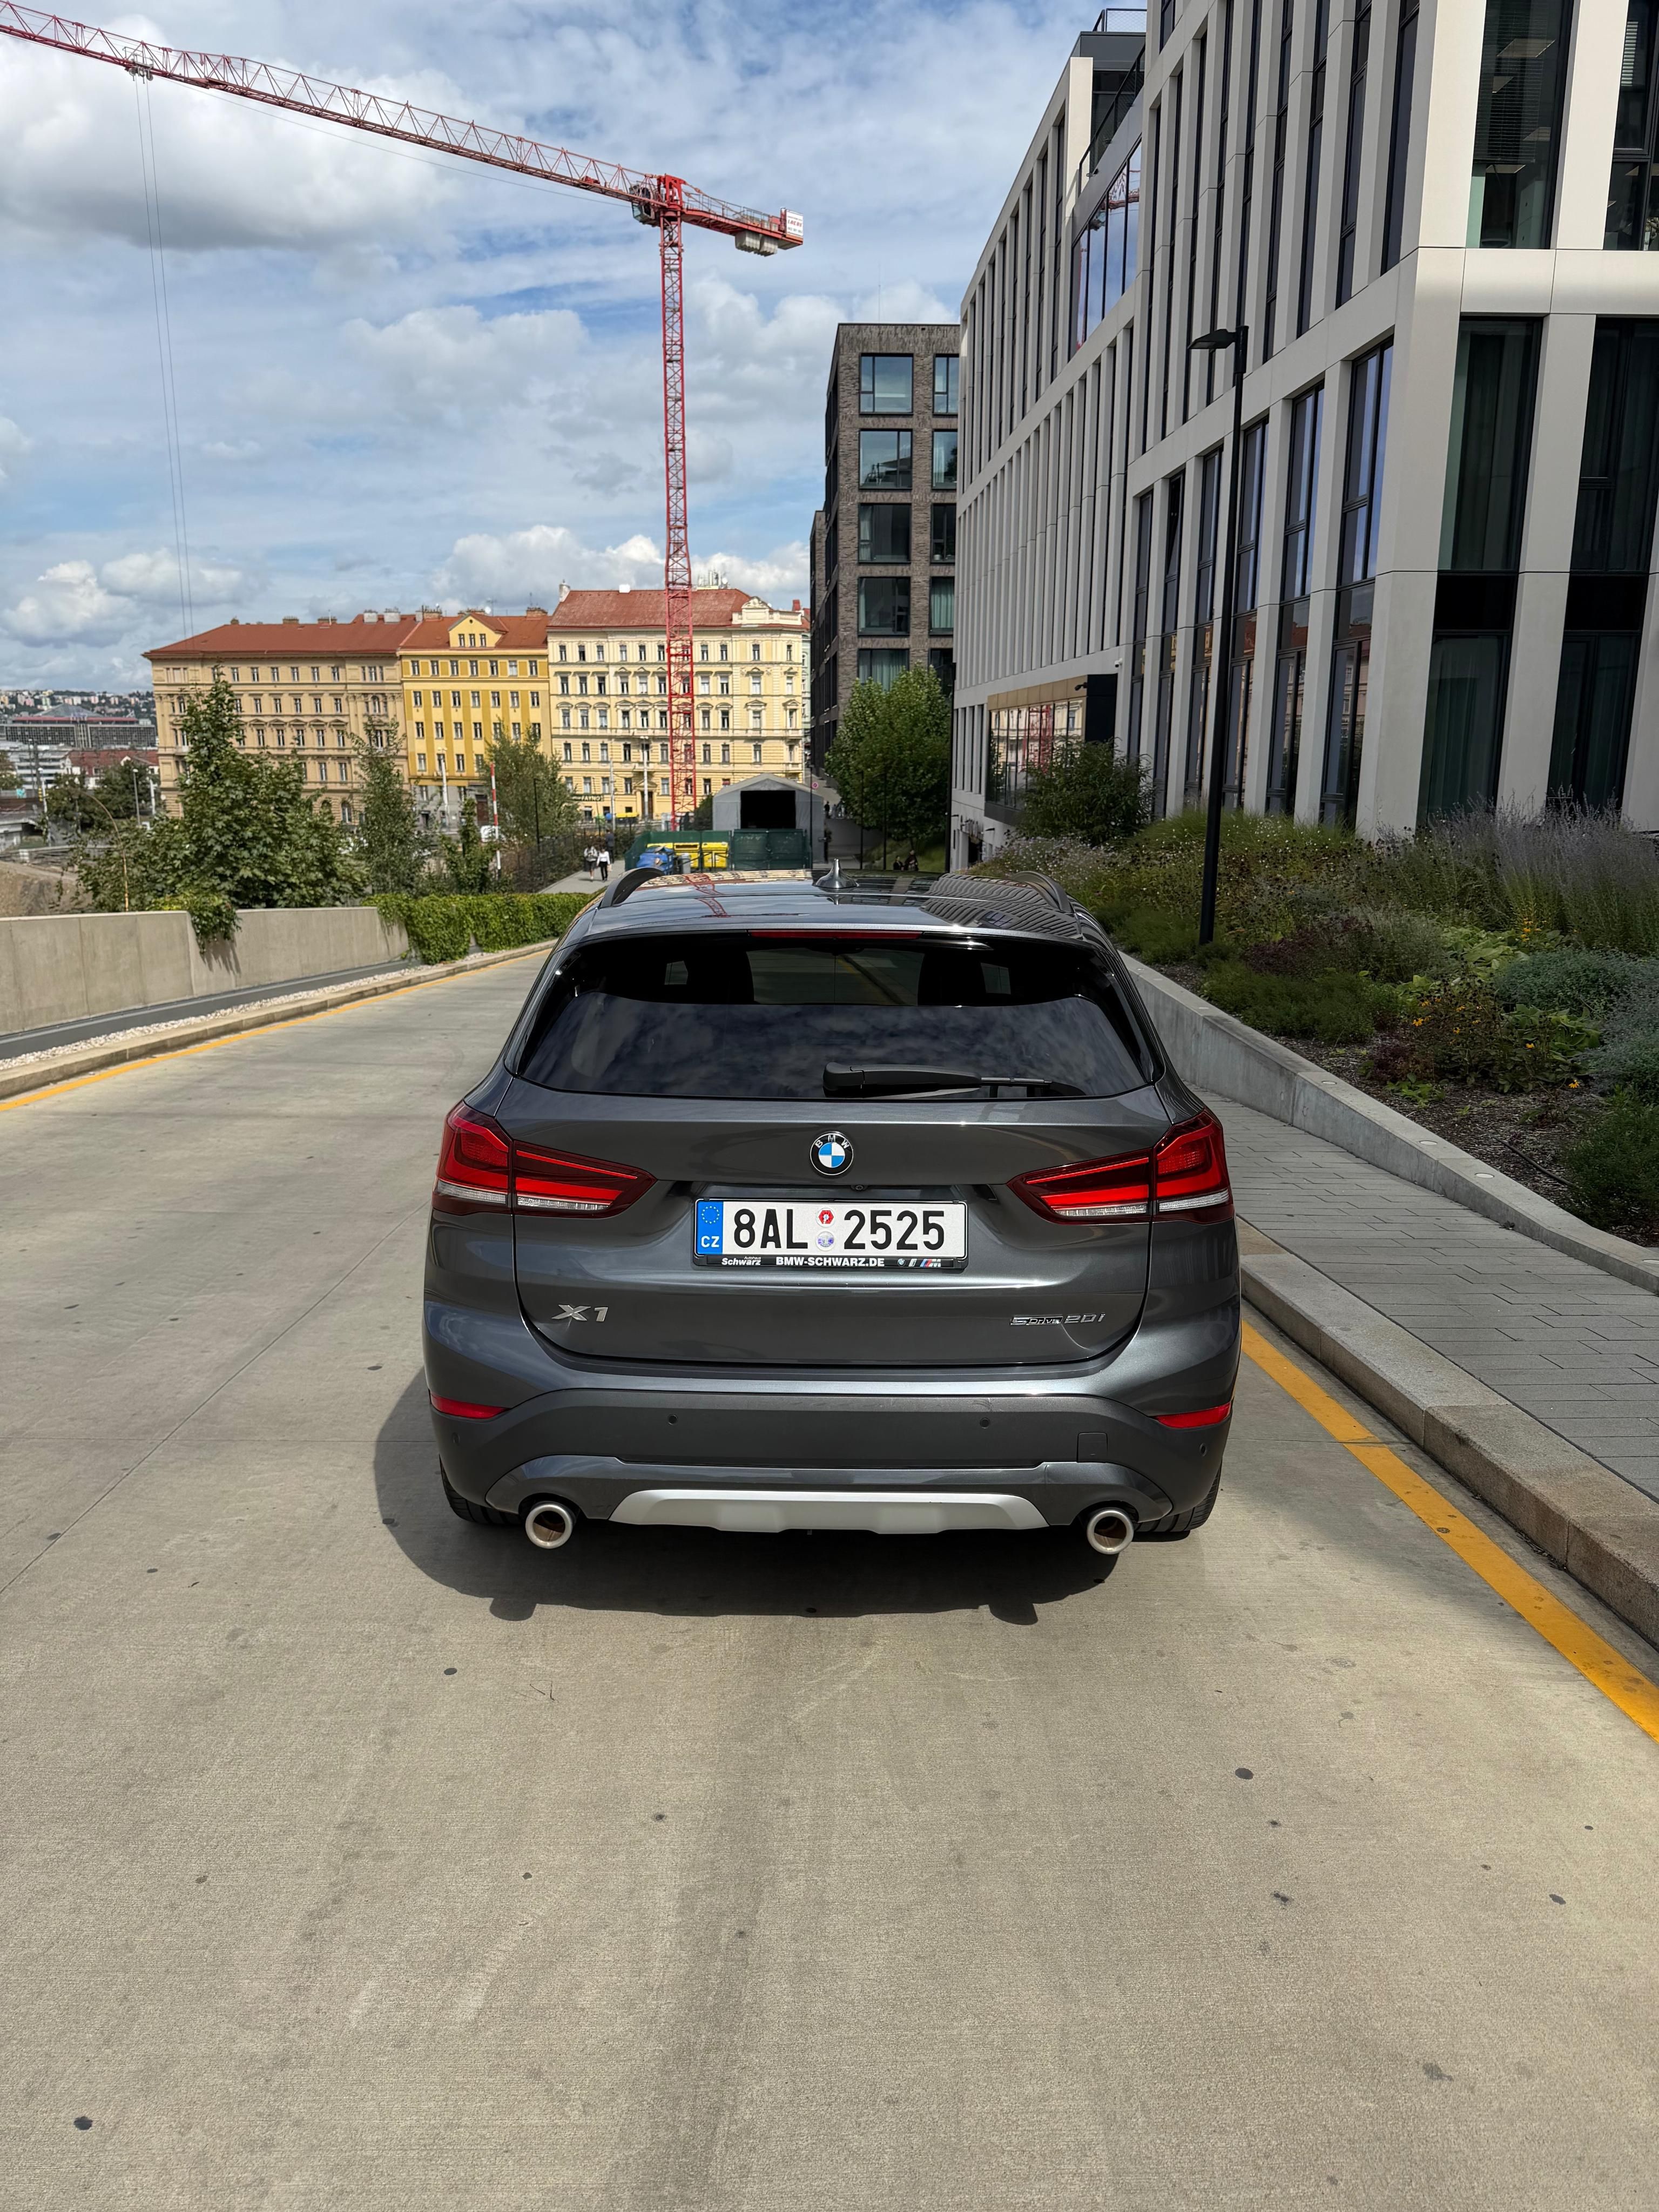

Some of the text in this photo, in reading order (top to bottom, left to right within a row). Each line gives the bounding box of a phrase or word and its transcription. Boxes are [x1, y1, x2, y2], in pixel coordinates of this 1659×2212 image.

[815, 1135, 850, 1149] BMW
[734, 1209, 945, 1250] 8AL 2525
[701, 1235, 720, 1248] CZ
[721, 1257, 761, 1266] Schwarz
[775, 1256, 885, 1266] BMW-SCHWARZ.DE
[551, 1304, 609, 1322] X1
